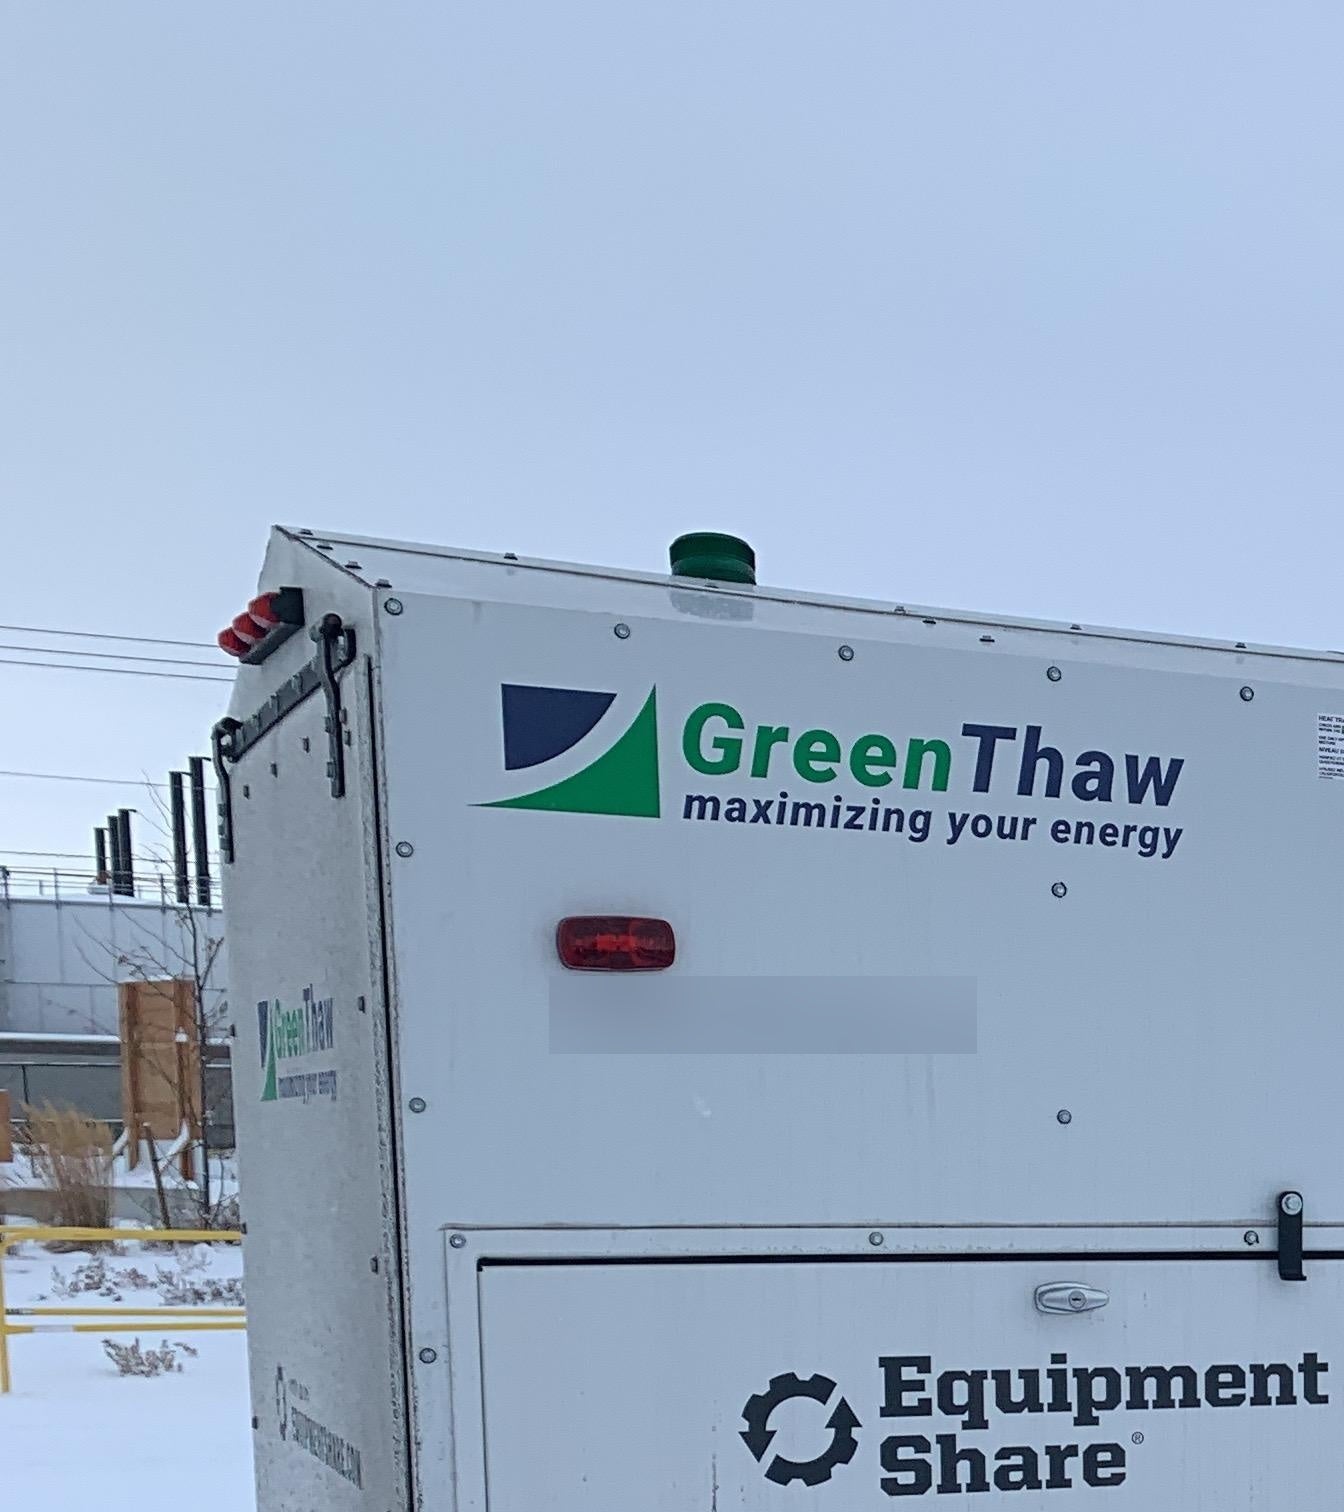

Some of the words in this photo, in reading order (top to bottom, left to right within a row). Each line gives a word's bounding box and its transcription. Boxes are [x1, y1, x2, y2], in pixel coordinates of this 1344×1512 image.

[681, 701, 1185, 807] GreenThaw
[683, 791, 932, 843] maximizing
[946, 811, 1039, 845] your
[1050, 818, 1183, 860] energy
[274, 983, 334, 1059] GreenThaw
[878, 1351, 1330, 1430] Equipment
